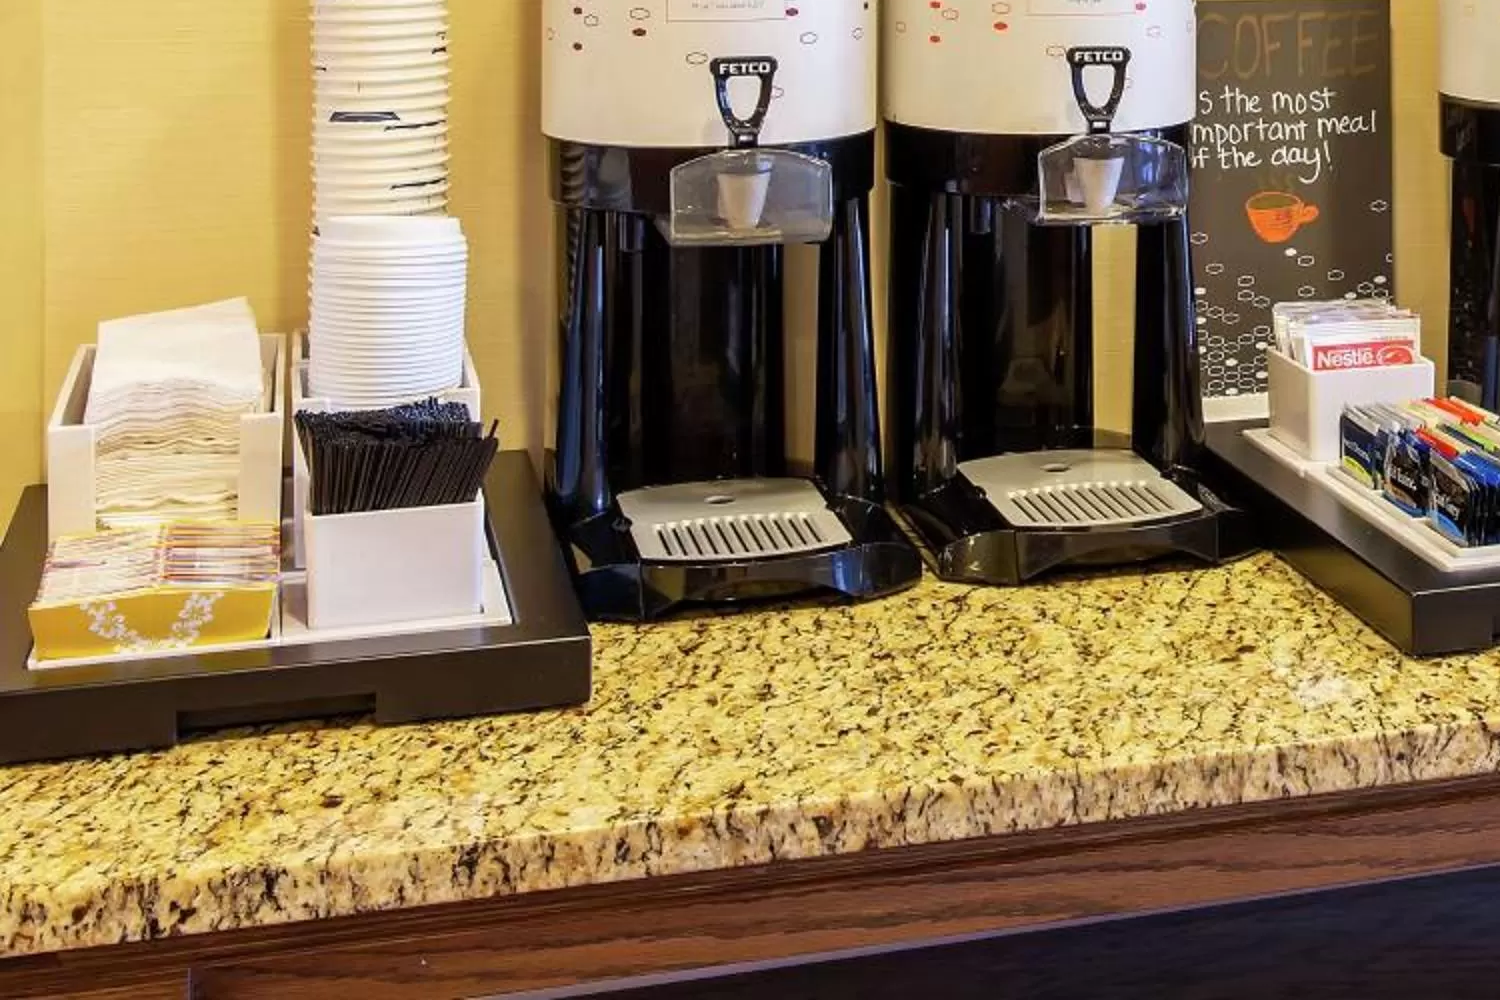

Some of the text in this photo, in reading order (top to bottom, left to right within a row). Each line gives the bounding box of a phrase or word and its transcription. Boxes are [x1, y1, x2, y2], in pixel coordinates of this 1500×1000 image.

[719, 61, 771, 75] FETCO
[1073, 50, 1124, 62] FETCO
[1219, 84, 1263, 115] the
[1272, 86, 1337, 114] most
[1192, 109, 1377, 152] mportant meal
[1217, 146, 1263, 169] the
[1270, 140, 1334, 184] day!
